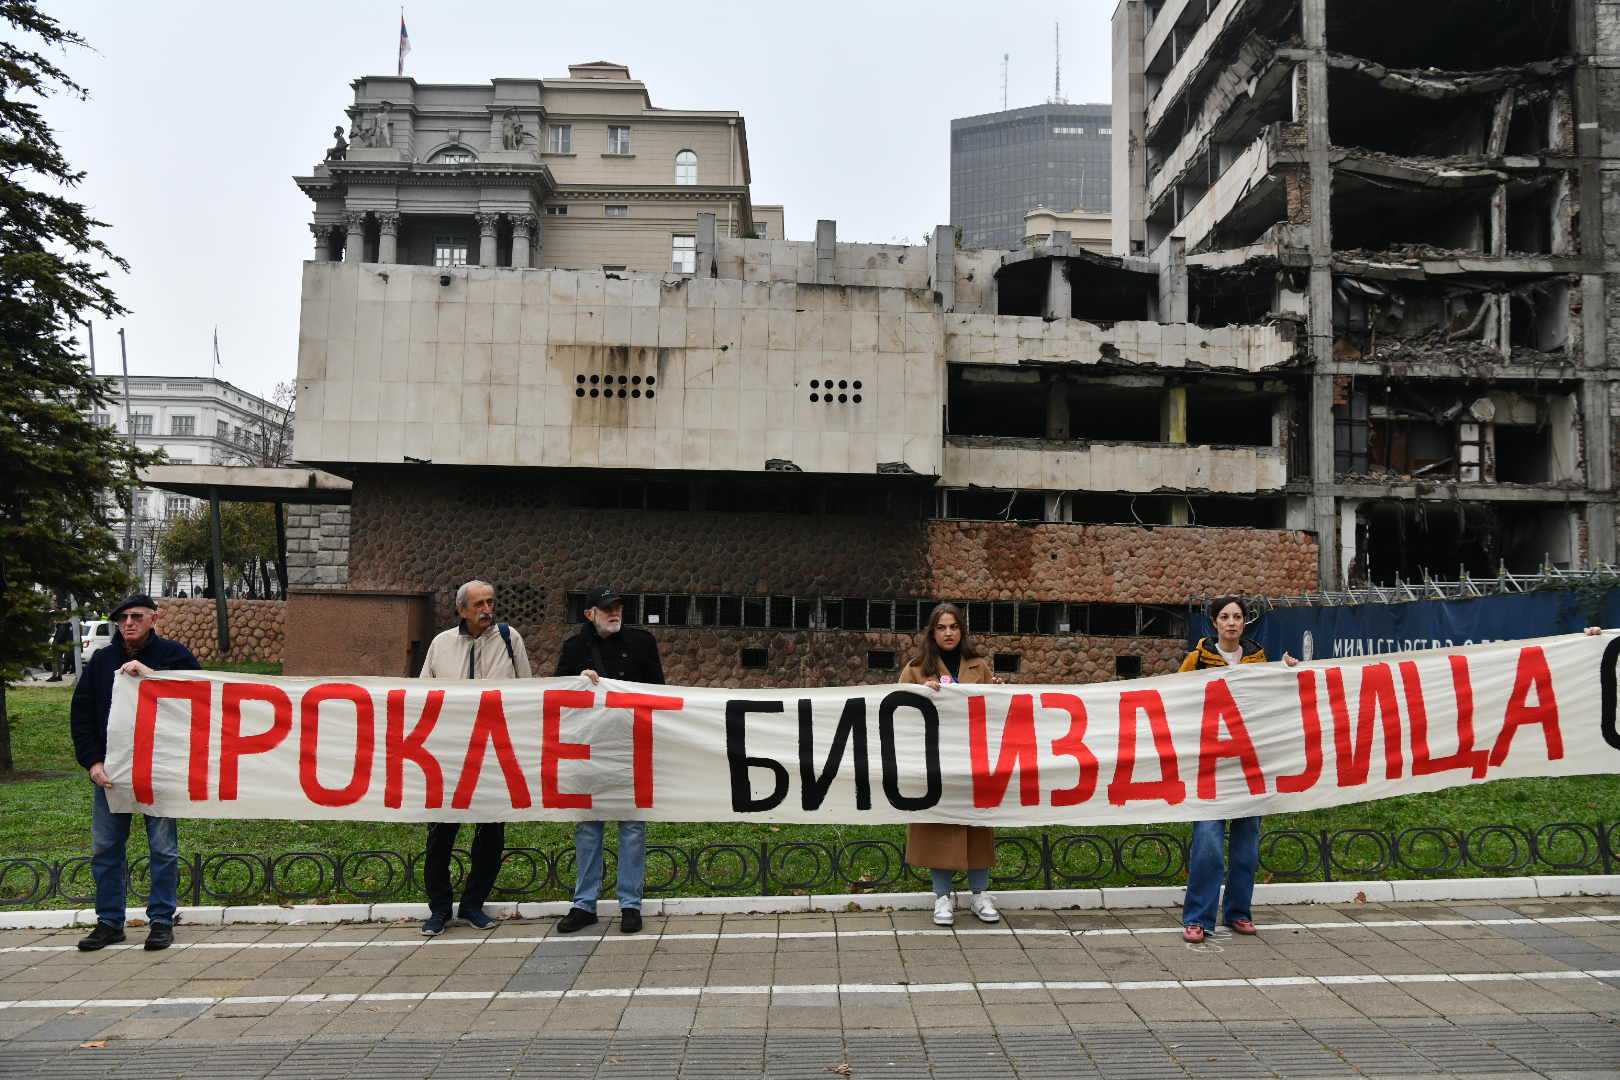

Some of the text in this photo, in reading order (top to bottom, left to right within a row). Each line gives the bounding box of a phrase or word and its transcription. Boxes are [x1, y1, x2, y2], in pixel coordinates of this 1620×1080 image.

[132, 679, 684, 810] ПРОКЛЕТ
[725, 690, 943, 813] БИО
[967, 646, 1564, 809] ИЗДАЈИЦА
